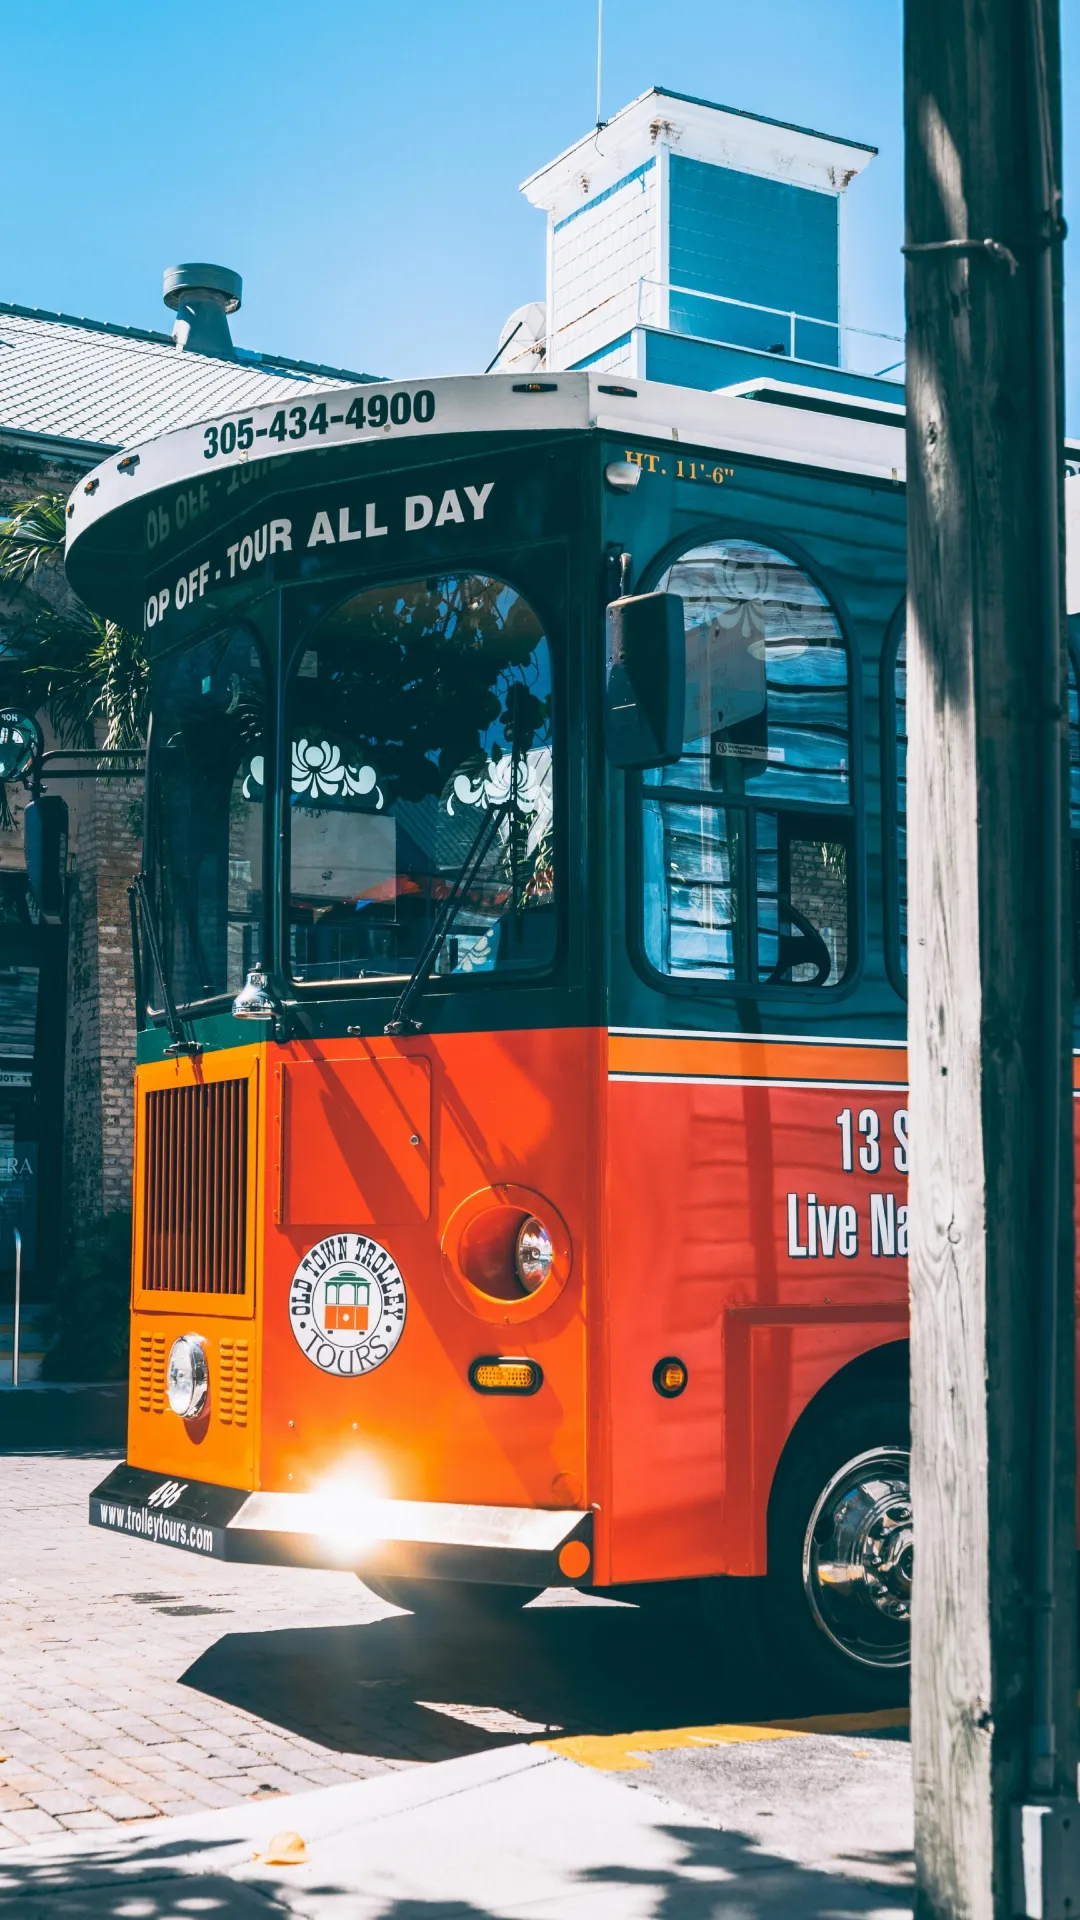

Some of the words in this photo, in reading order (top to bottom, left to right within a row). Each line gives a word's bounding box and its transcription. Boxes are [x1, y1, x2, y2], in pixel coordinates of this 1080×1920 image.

[203, 389, 435, 459] 305-434-4900
[144, 588, 169, 631] OP
[175, 561, 210, 610] OFF
[227, 518, 292, 578] TOUR
[307, 502, 388, 548] ALL
[405, 482, 495, 533] DAY
[836, 1108, 881, 1174] 13
[787, 1193, 859, 1258] Live
[291, 1278, 313, 1316] OLD
[302, 1236, 348, 1278] TOWN
[355, 1236, 405, 1320] TROLLEY
[305, 1328, 388, 1374] TOURS
[100, 1503, 213, 1551] www.trolleytours.com
[147, 1480, 188, 1509] 496
